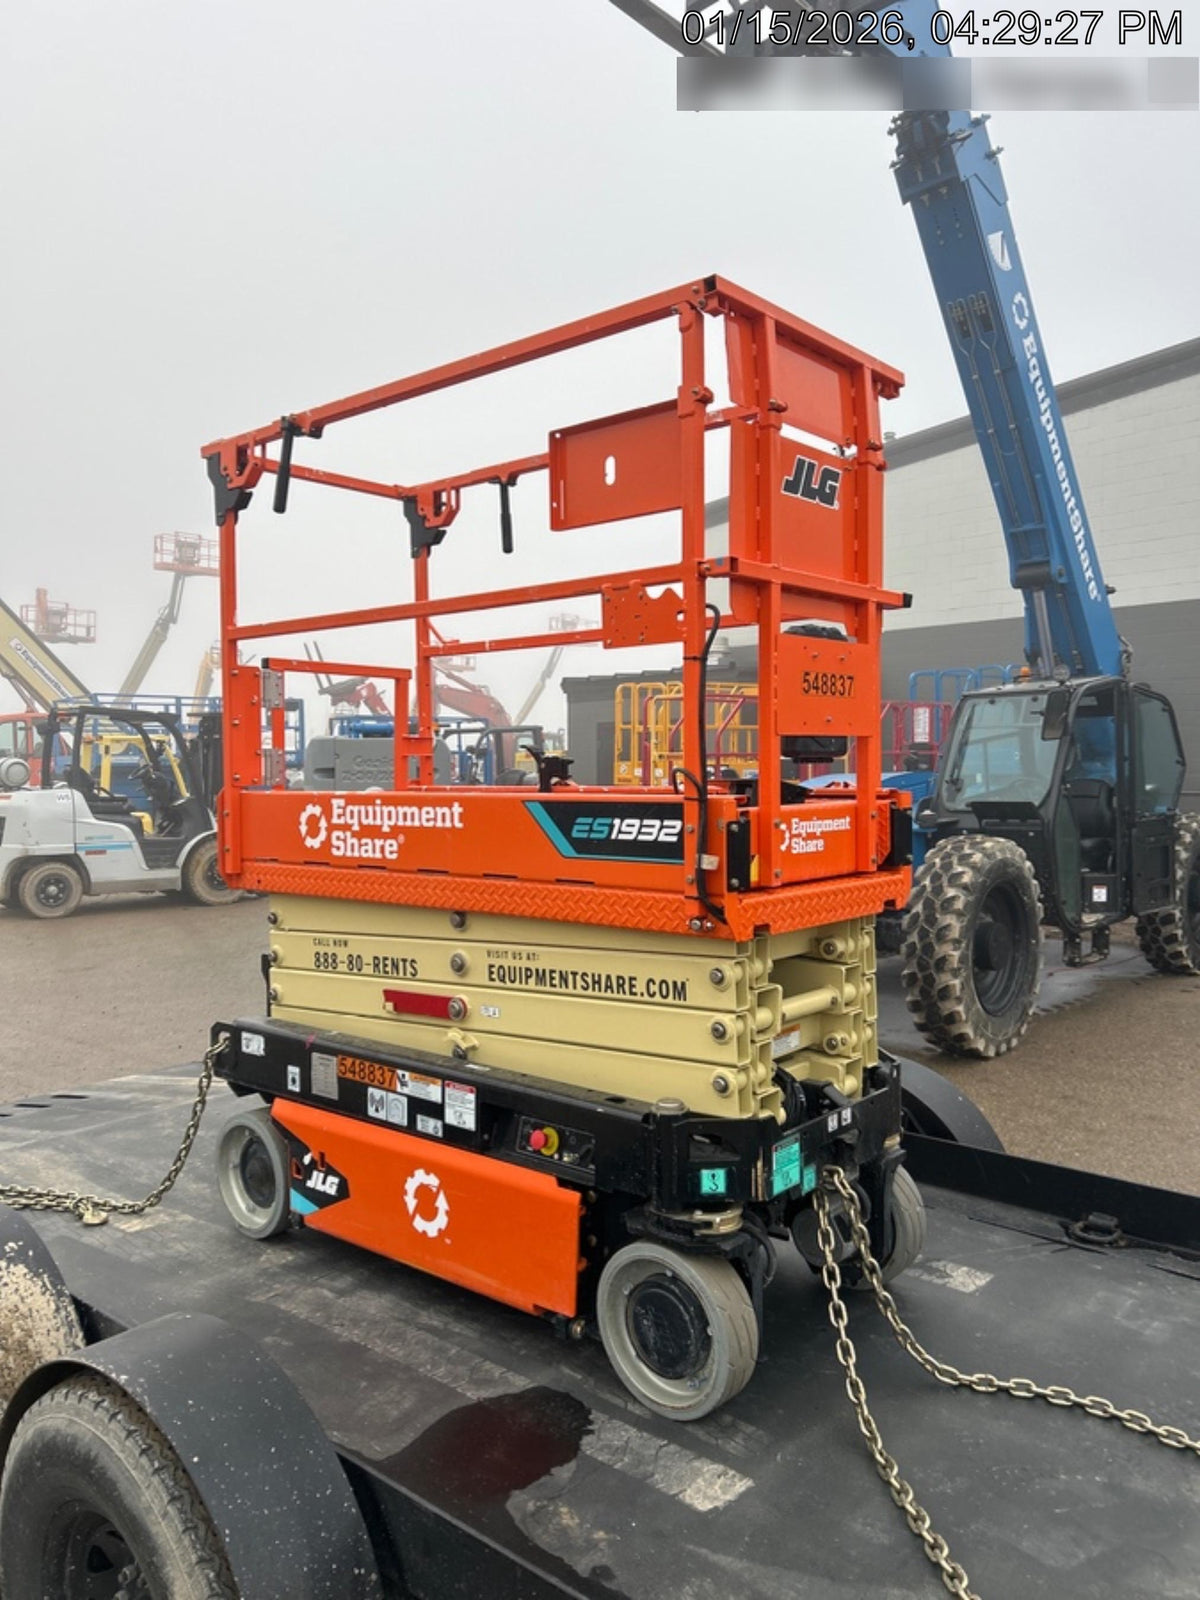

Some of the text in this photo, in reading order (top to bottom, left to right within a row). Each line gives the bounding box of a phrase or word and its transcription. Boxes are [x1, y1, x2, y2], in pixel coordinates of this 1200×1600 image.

[1022, 331, 1101, 601] EquipmentShare
[781, 455, 841, 510] JLG
[802, 671, 854, 697] 548837
[330, 798, 464, 832] Equipment
[791, 816, 850, 837] Equipment
[571, 817, 683, 842] ES1932
[791, 838, 825, 854] Share
[312, 937, 349, 949] CALL NOW
[486, 950, 509, 960] VISIT
[512, 951, 524, 961] US
[313, 950, 419, 978] 888-80-RENTS
[487, 963, 688, 1002] EQUIPMENTSHARE.COM
[339, 1056, 397, 1088] 548837
[306, 1170, 339, 1196] JLG
